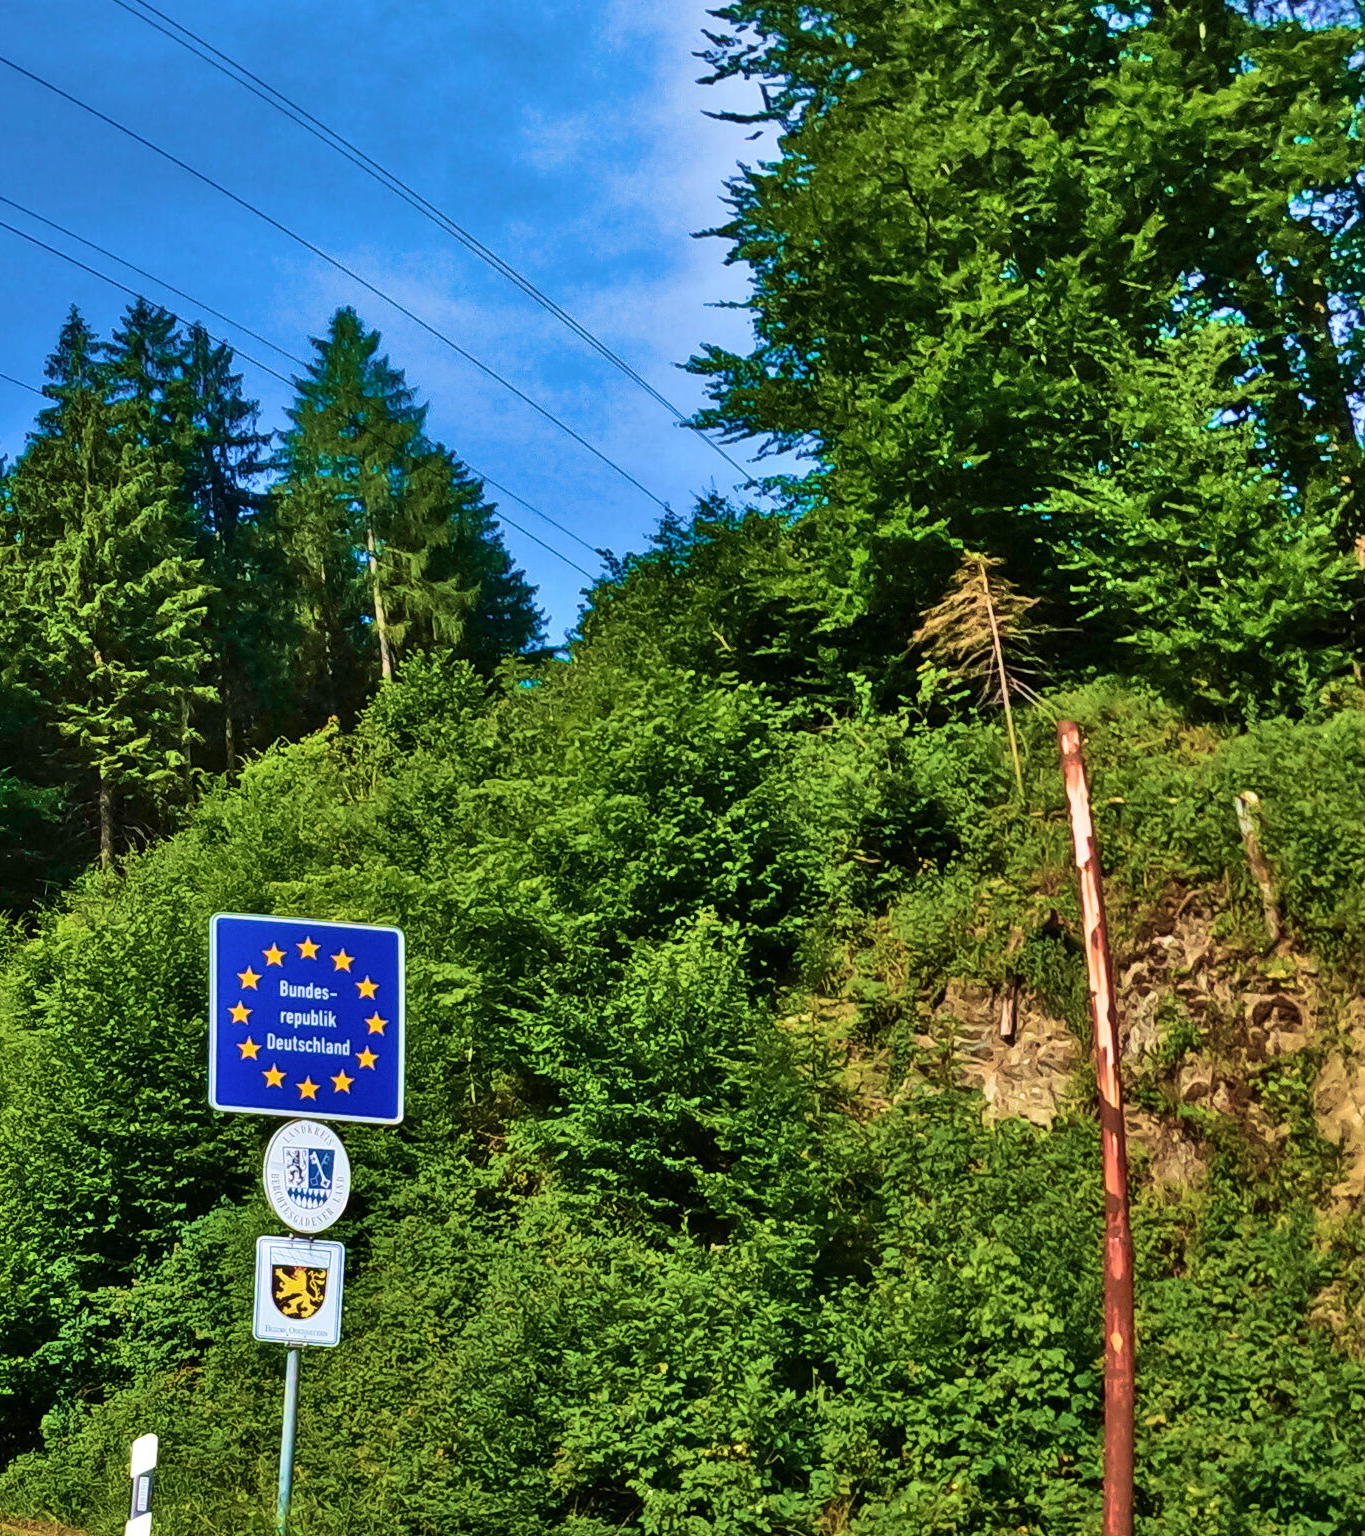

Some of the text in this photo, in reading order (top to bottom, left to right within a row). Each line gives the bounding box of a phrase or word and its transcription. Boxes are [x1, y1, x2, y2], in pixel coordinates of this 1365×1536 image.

[279, 979, 338, 1000] Bundes-
[280, 1009, 337, 1029] republik
[266, 1032, 351, 1056] Deutschland
[283, 1124, 334, 1146] LANDKREIS
[332, 1176, 345, 1204] LAND
